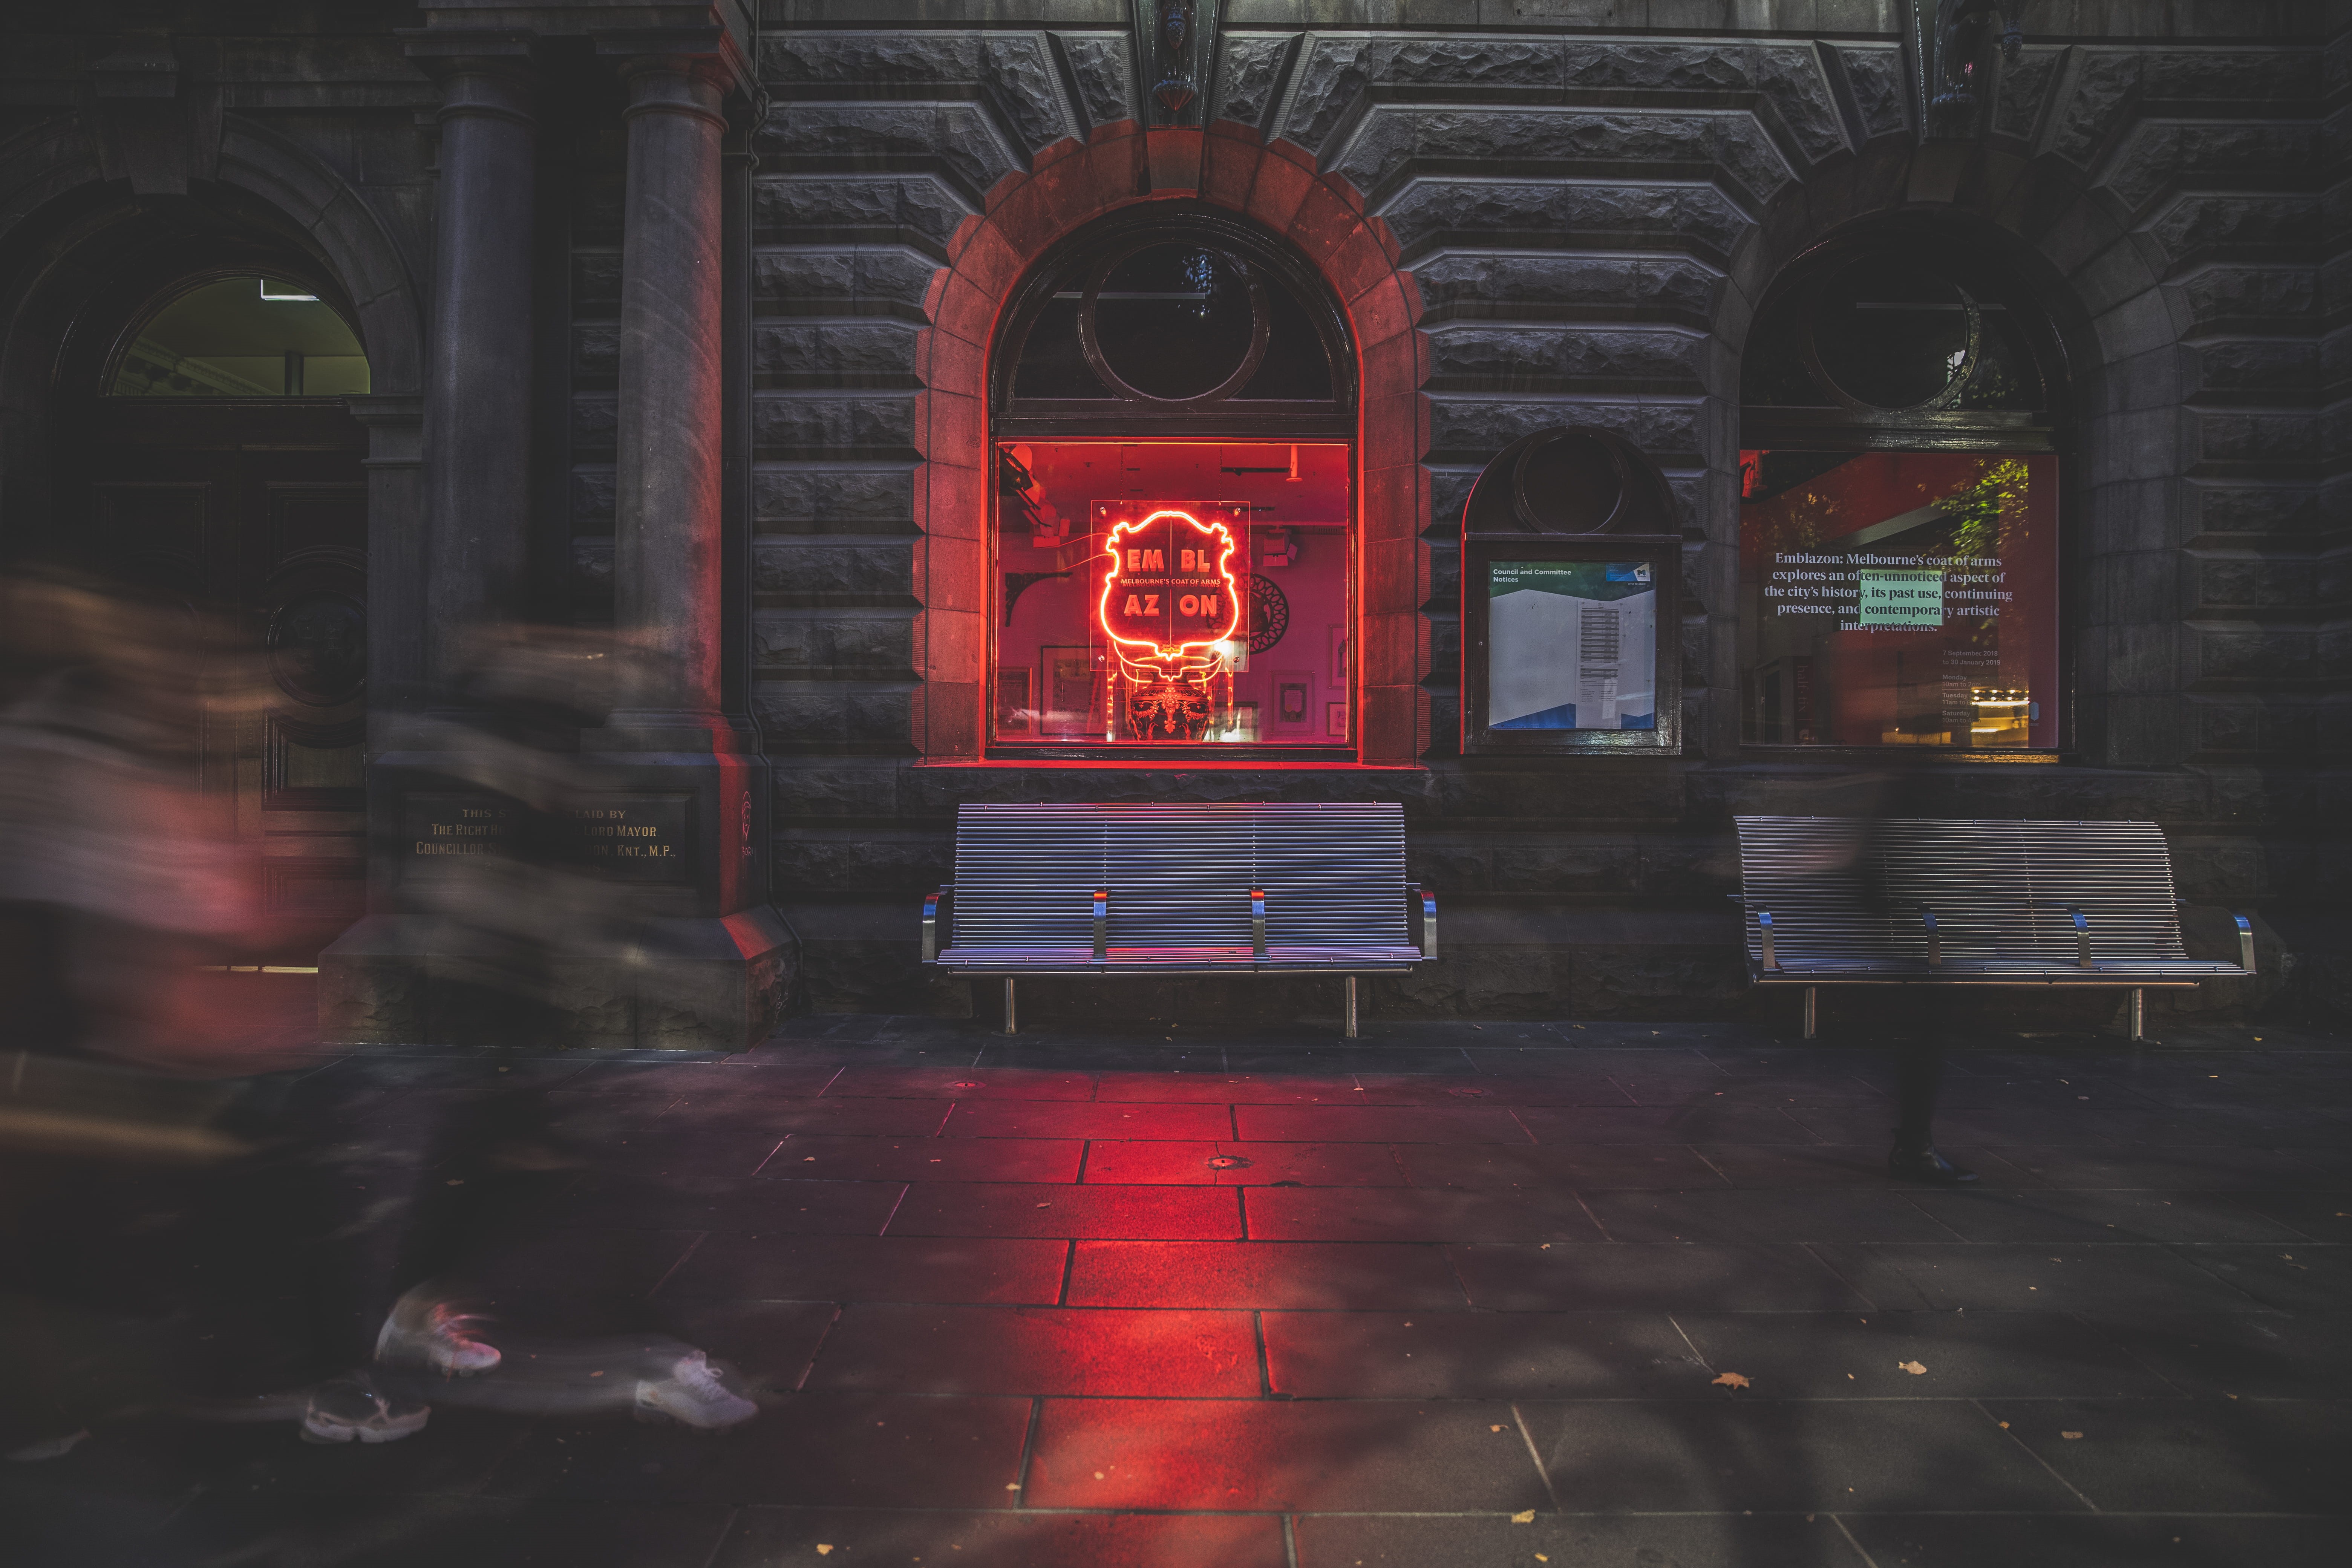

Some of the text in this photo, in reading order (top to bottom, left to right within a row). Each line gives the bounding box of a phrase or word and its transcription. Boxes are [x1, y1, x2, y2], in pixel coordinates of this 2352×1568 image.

[1127, 549, 1210, 571] EM BL
[1776, 553, 2002, 567] Emblazon: Melbourne’s coat of arms
[1773, 569, 2006, 585] explores an often-unnoticed aspect of
[1765, 585, 2013, 602] the city’s history, its past use, continuing
[1124, 594, 1217, 617] AZ ON
[1777, 604, 2000, 618] presence, and contemporary artistic
[1841, 620, 1937, 633] interpretations.
[462, 809, 492, 818] THIS
[576, 810, 604, 819] LAID
[609, 810, 626, 819] BY
